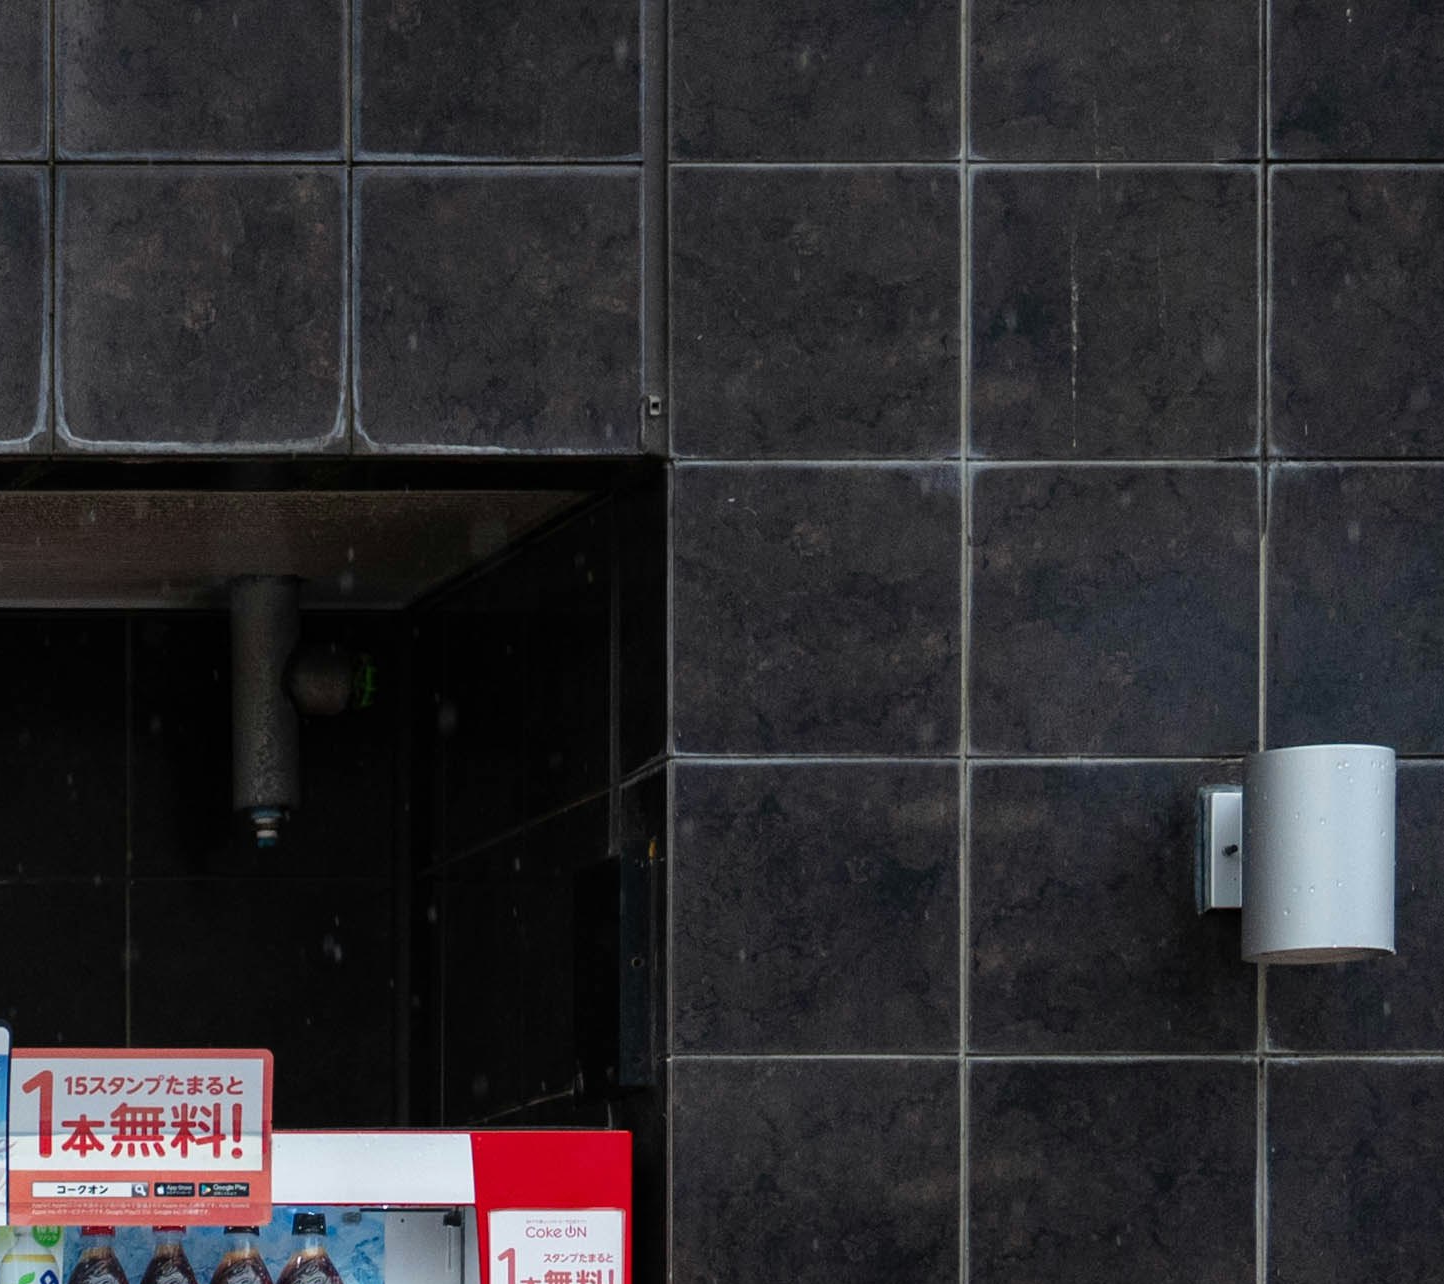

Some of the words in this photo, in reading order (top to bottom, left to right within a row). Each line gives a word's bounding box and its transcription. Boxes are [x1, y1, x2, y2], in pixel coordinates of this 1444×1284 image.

[64, 1076, 243, 1096] 15スタンプたまると
[57, 1184, 109, 1194] コークオン
[213, 1184, 233, 1192] Google
[234, 1184, 247, 1192] Play
[525, 1227, 562, 1238] Coke
